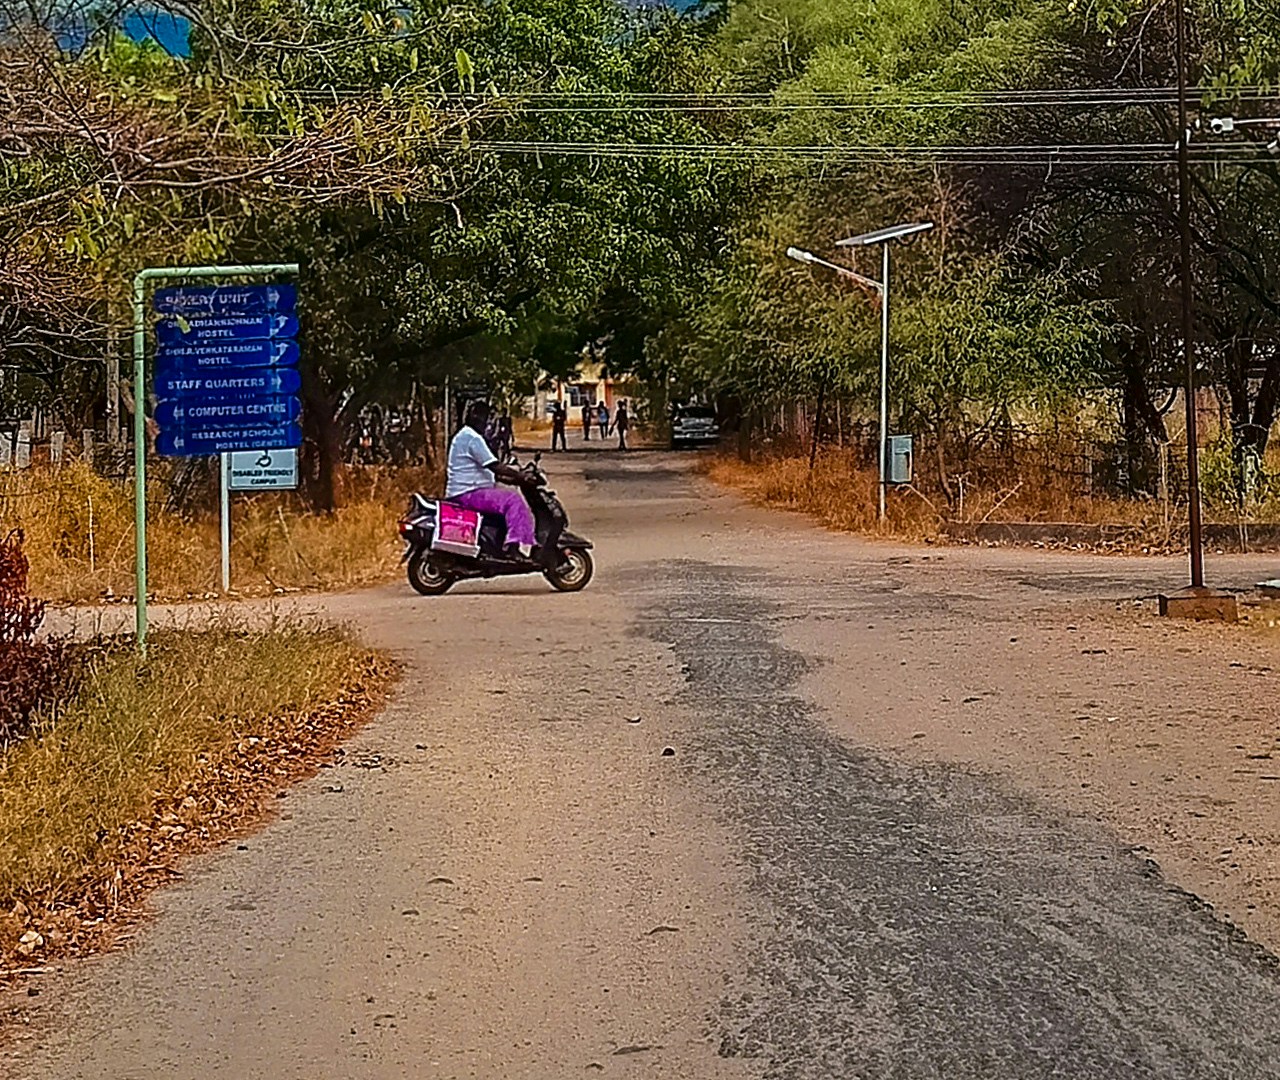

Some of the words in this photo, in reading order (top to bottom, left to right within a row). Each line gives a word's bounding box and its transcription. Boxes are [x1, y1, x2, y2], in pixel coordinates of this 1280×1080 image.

[197, 329, 235, 338] HOSTEL
[198, 356, 232, 366] HOSTEL
[167, 379, 202, 390] STAFF
[205, 377, 265, 389] QUARTERS
[188, 404, 244, 417] COMPUTER
[246, 402, 287, 414] CENTRE
[191, 430, 240, 440] RESEARCH
[242, 428, 285, 438] SCHOLAR
[215, 441, 249, 450] HOSTEL
